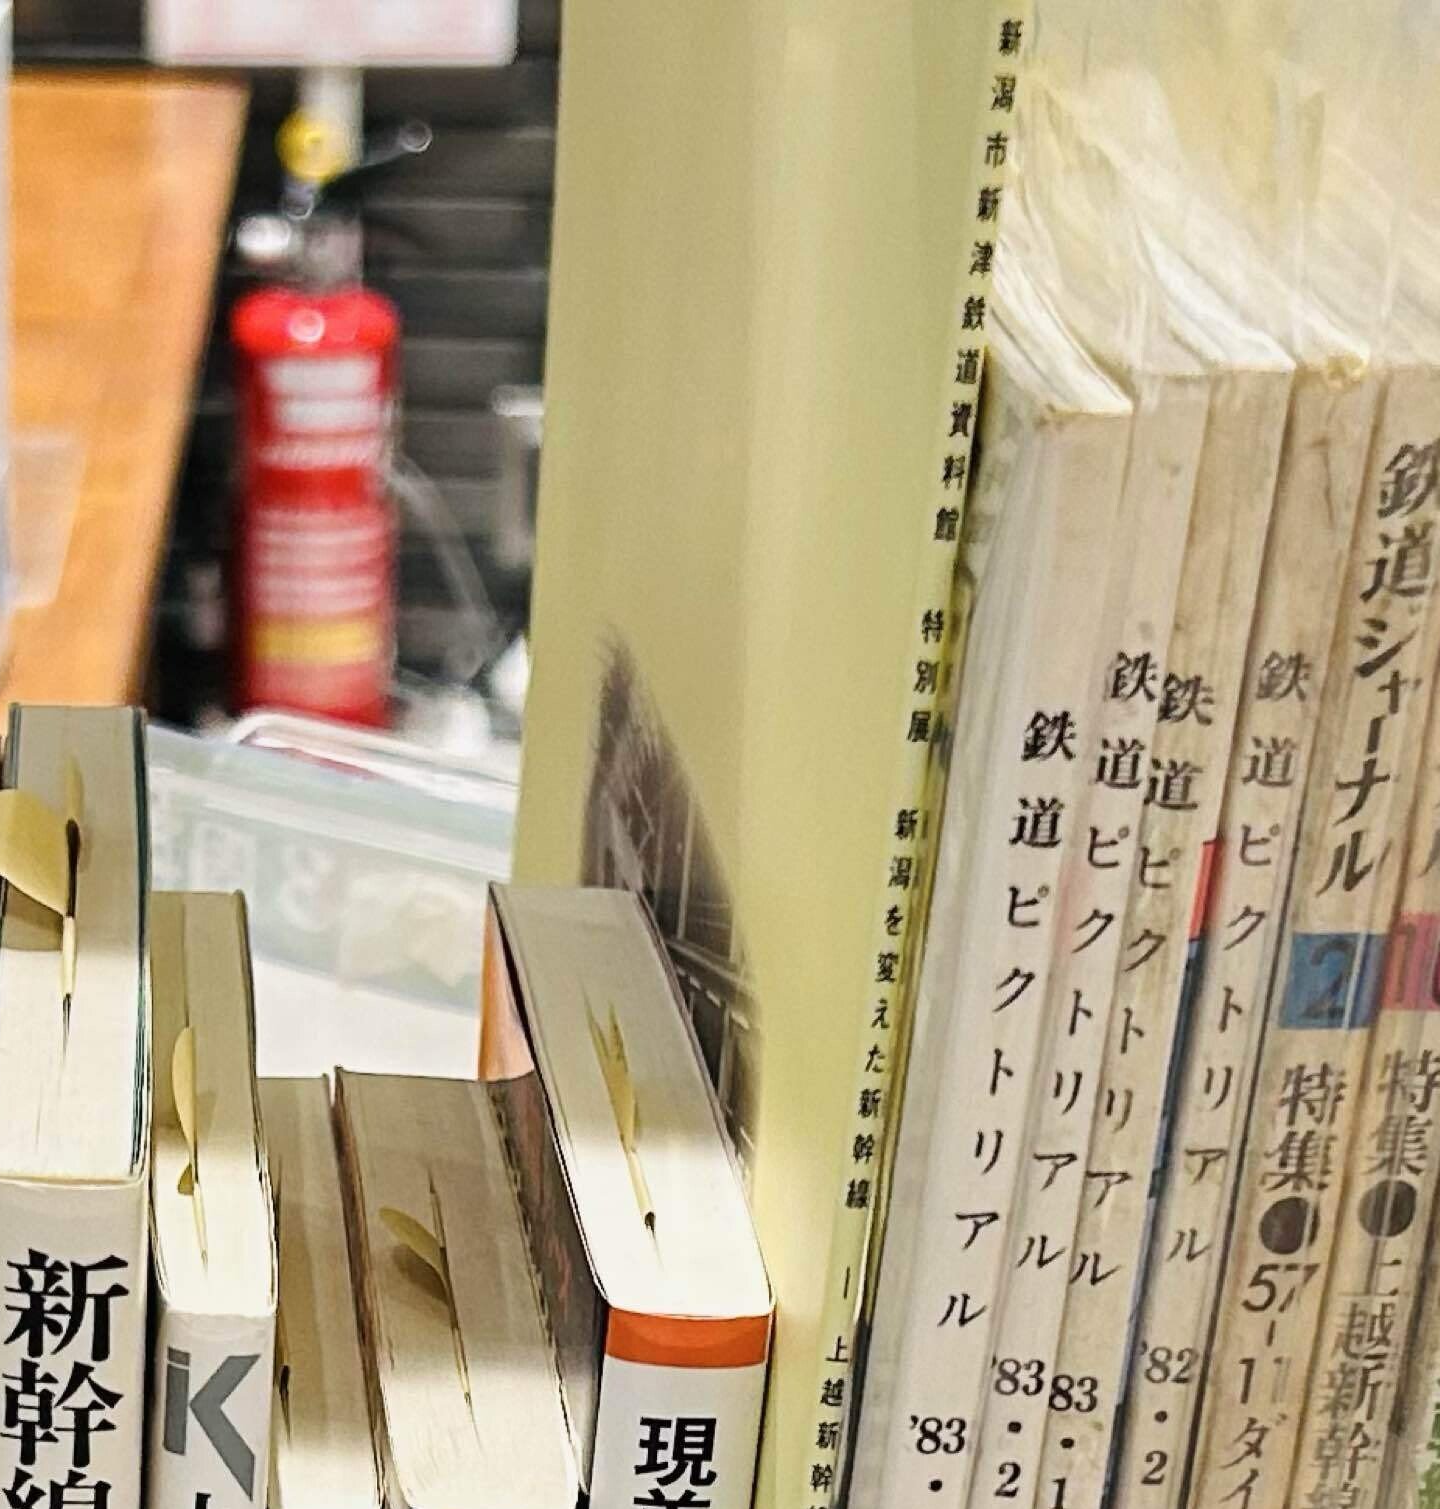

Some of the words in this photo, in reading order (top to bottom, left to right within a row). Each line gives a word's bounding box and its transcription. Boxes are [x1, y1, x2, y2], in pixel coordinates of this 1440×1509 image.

[845, 808, 920, 1211] 新潟を変えた新幹線
[936, 710, 1077, 1329] 鉄道ピクトリアル
[1017, 649, 1160, 1271] 鉄道ピクトリアル
[1068, 672, 1215, 1288] 鉄道ピクトリアル
[1165, 649, 1312, 1262] 鉄道ピクトリアル
